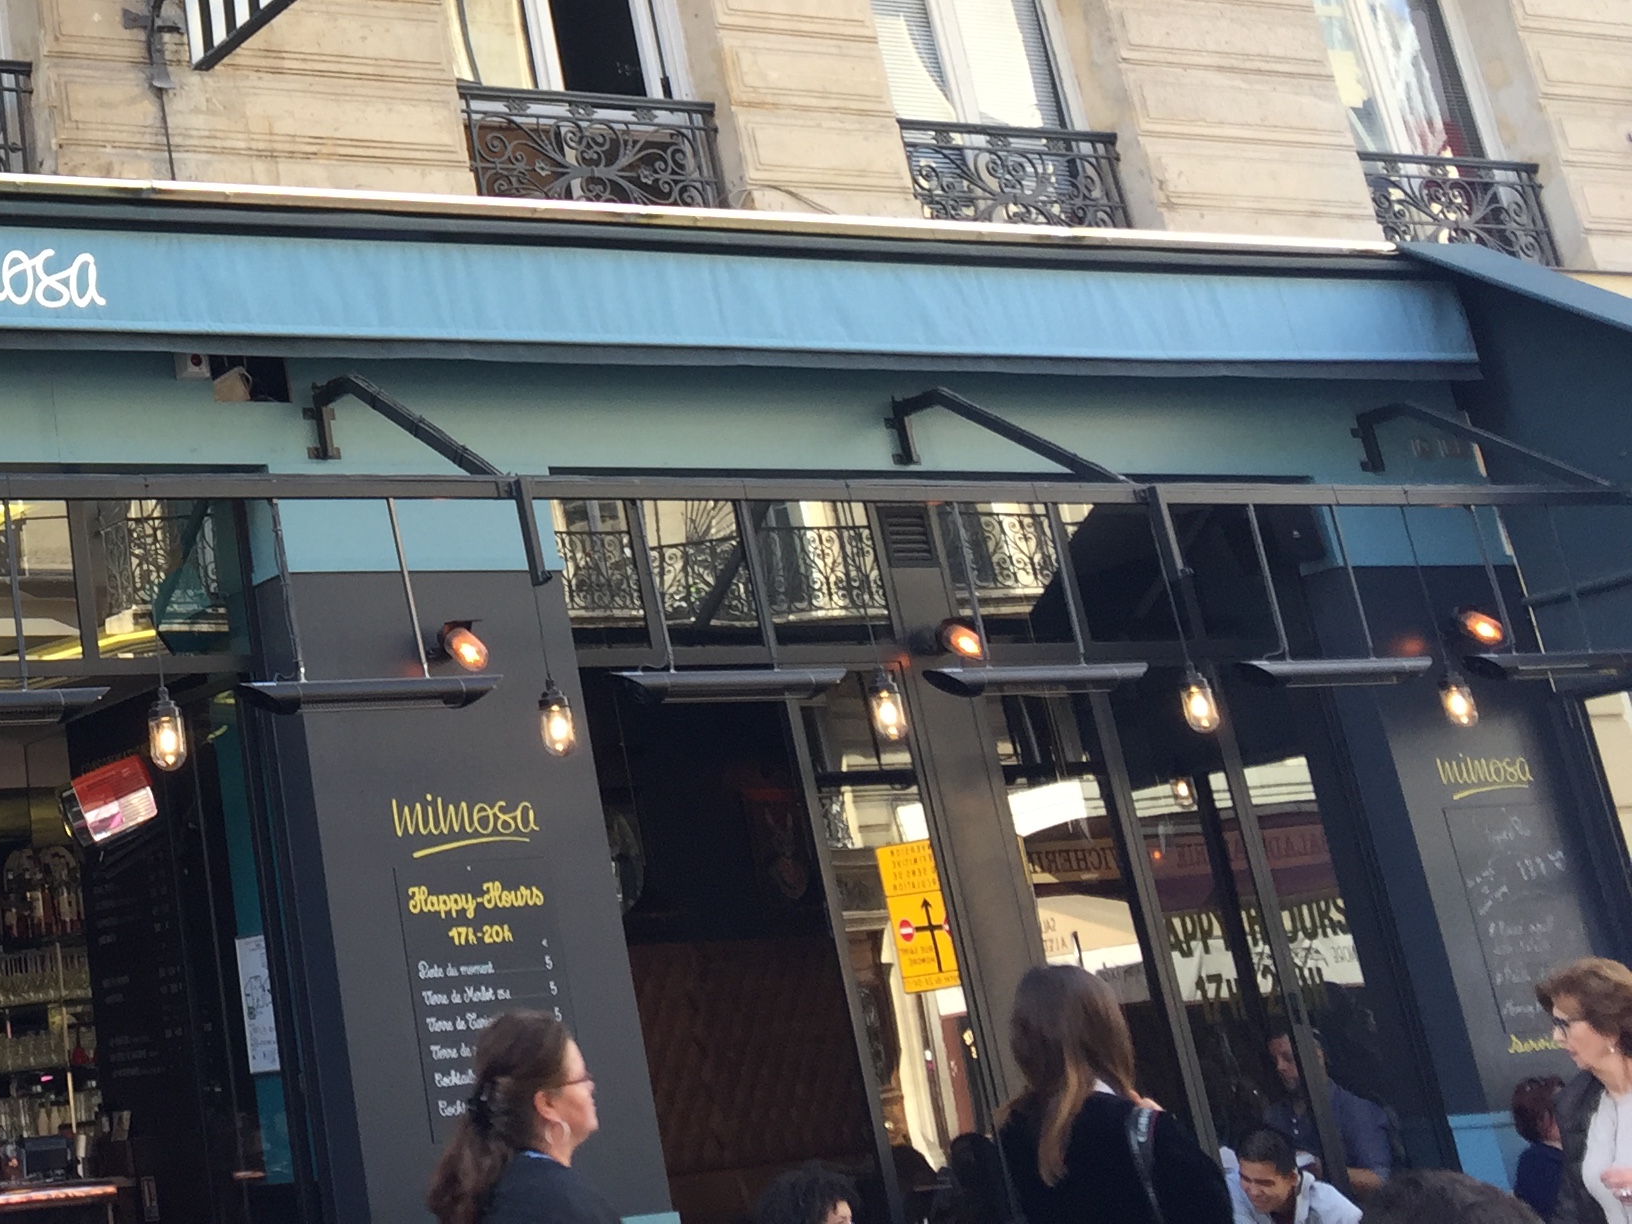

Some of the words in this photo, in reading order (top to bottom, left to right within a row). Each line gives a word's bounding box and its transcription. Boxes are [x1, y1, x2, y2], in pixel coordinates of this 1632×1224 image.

[1436, 753, 1534, 785] mimosa
[392, 793, 540, 837] mimosa
[408, 881, 544, 919] Happy-Hours
[448, 924, 513, 946] 17h-20h
[545, 954, 553, 970] 5
[549, 980, 558, 996] 5
[554, 1006, 563, 1022] 5
